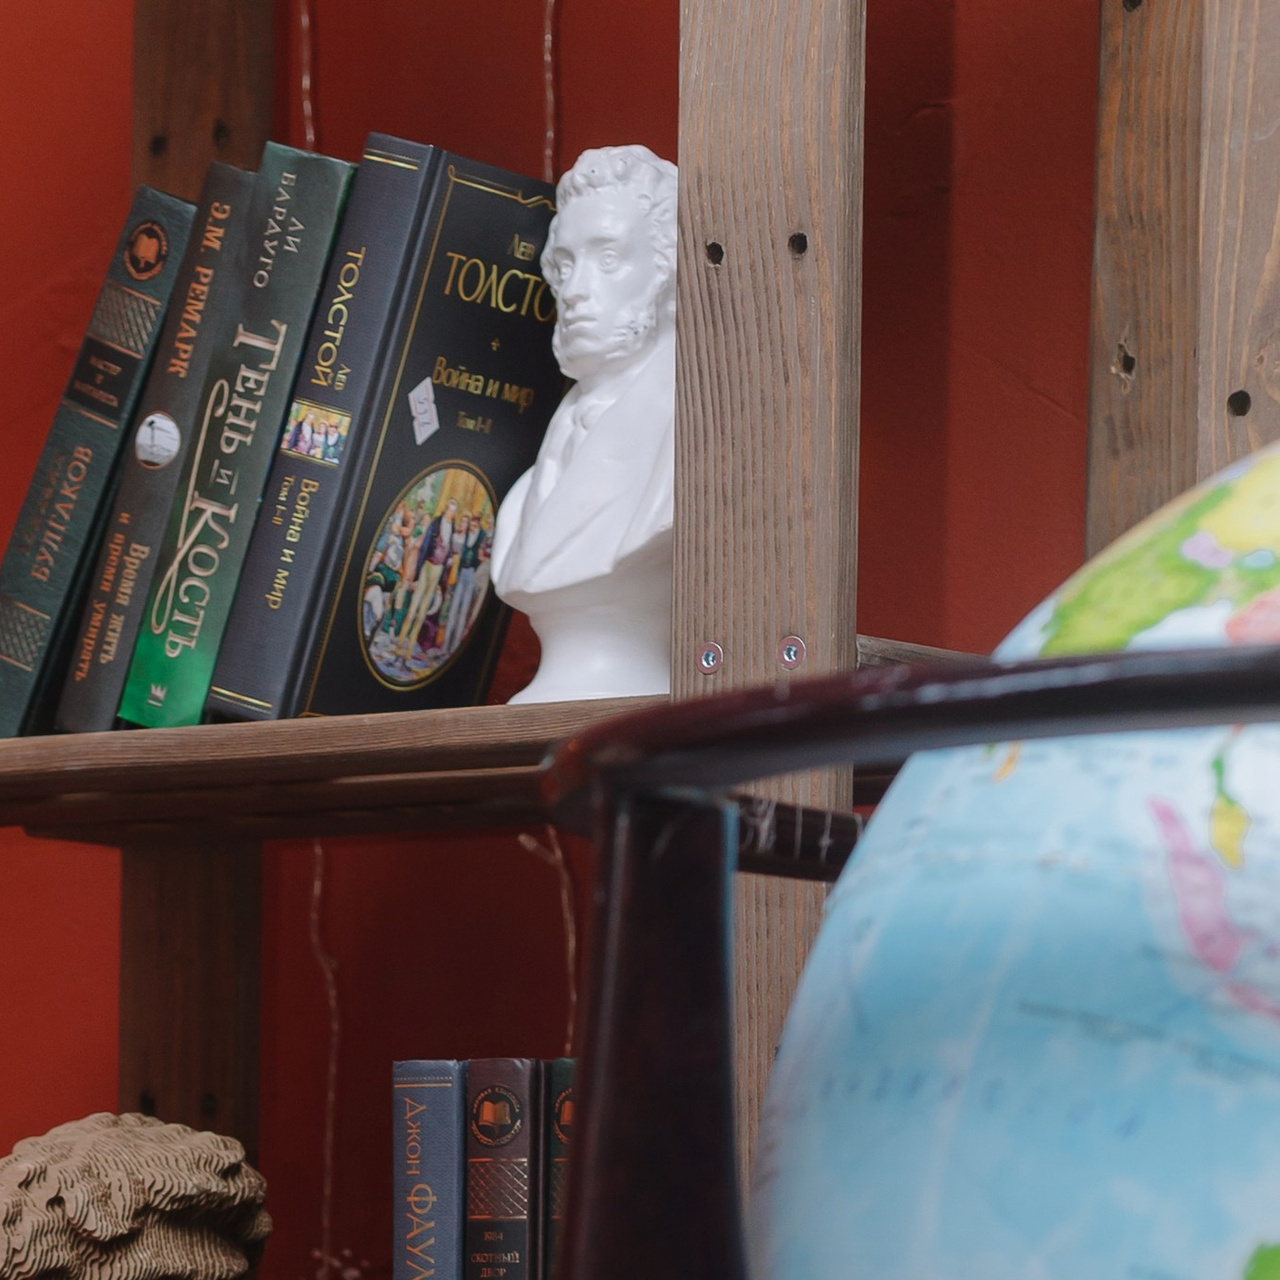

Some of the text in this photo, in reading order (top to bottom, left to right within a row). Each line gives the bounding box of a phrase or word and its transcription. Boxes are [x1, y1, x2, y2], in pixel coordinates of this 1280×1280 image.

[283, 217, 305, 254] ЛИ
[444, 251, 558, 322] ТОЛСТО
[167, 265, 215, 378] РЕМАРК
[310, 246, 366, 387] ТОЛСТОЙ
[432, 356, 484, 395] Война
[29, 445, 94, 582] БУЛГАКОВ
[265, 478, 320, 610] Война и мир
[75, 600, 107, 681] умирать
[99, 542, 151, 664] Время жить
